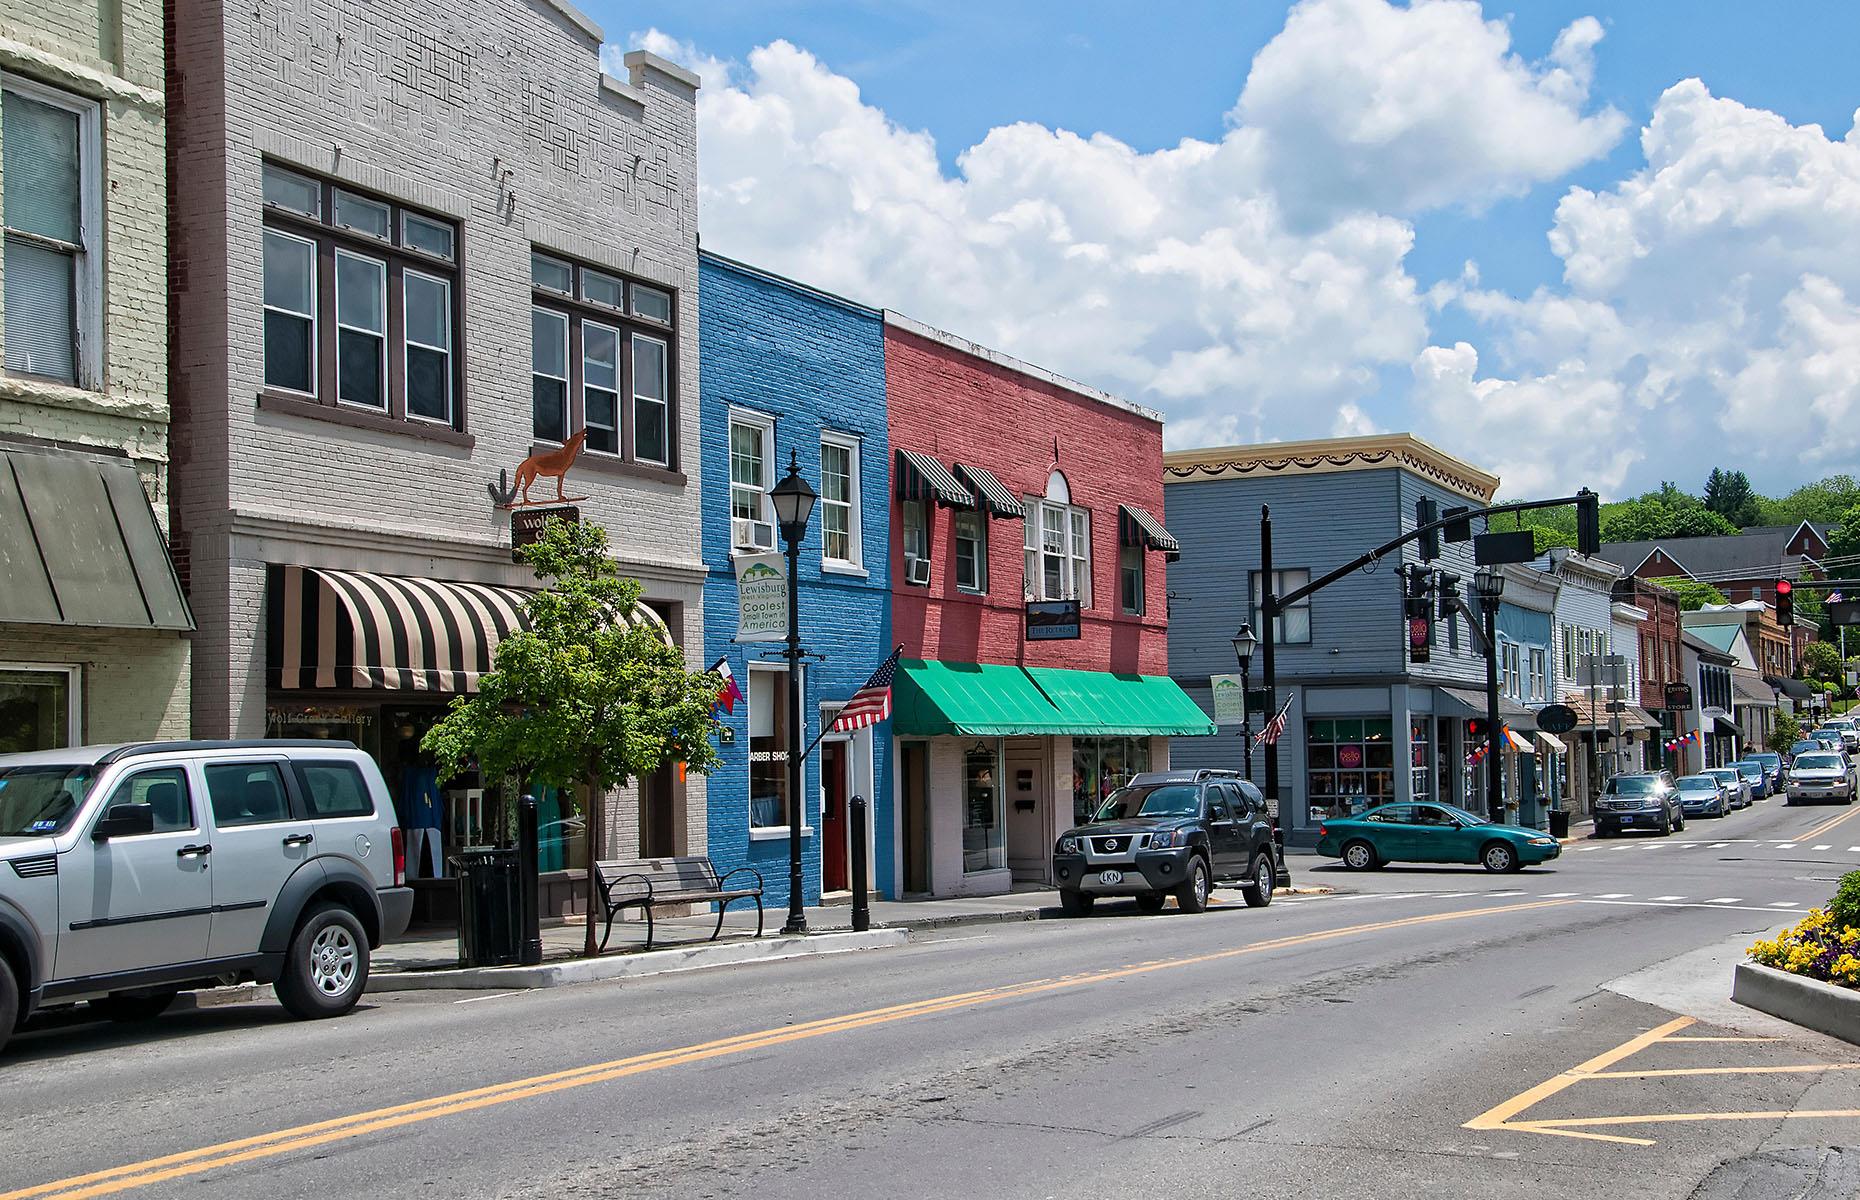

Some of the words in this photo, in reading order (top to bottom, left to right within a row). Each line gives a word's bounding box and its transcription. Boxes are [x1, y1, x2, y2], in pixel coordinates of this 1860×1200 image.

[740, 582, 786, 597] Lewisburg
[743, 601, 785, 612] Coolest
[742, 619, 785, 629] America
[749, 751, 770, 762] ARBER
[1103, 872, 1119, 882] LKN
